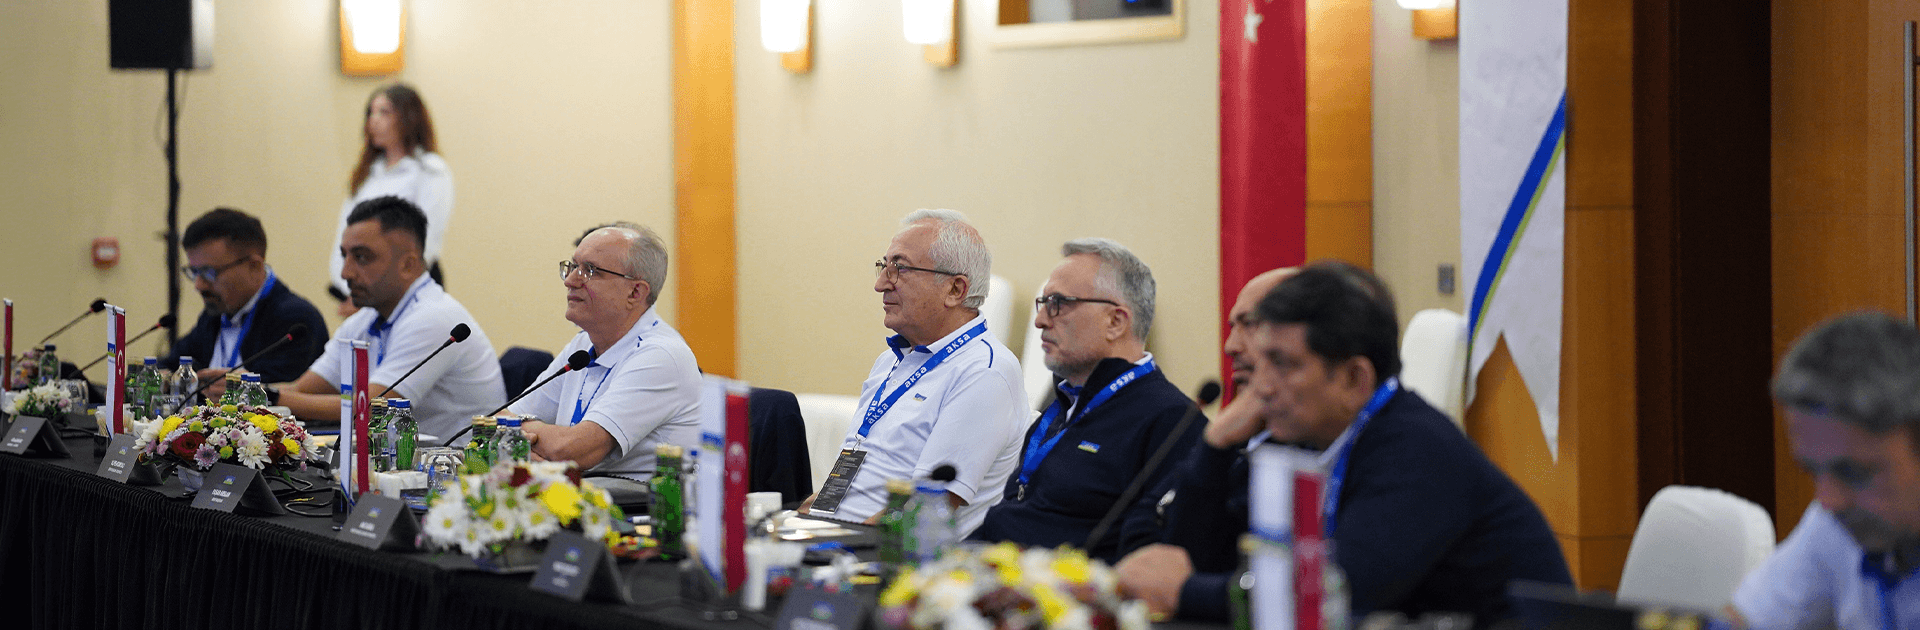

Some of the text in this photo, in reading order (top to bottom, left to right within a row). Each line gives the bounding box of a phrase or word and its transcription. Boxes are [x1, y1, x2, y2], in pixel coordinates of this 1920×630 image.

[945, 333, 971, 354] aksa
[904, 366, 927, 388] aksa
[867, 402, 889, 424] aksa
